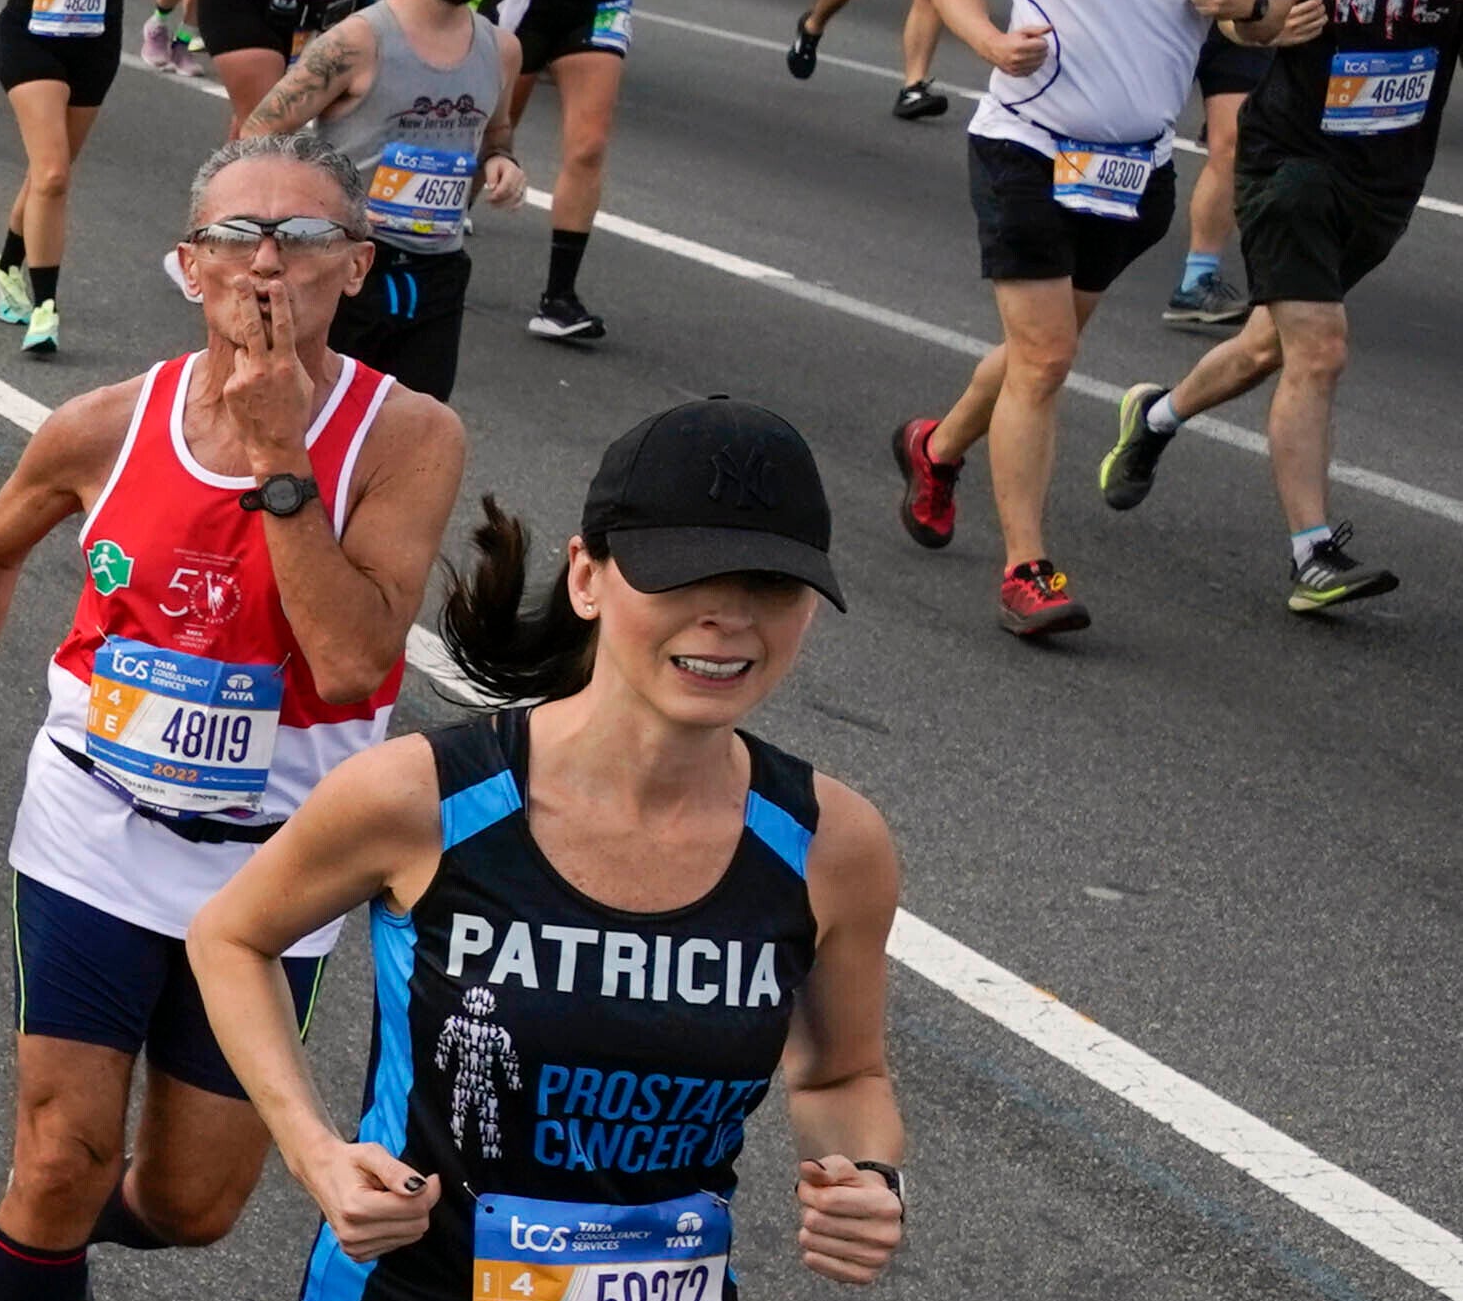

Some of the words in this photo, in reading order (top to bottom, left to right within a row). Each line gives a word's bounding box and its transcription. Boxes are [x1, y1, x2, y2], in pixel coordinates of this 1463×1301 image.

[1371, 74, 1426, 104] 46485
[394, 151, 419, 168] tcs
[1097, 159, 1145, 190] 48300
[414, 179, 466, 206] 46578
[112, 648, 149, 681] tcs
[152, 658, 179, 672] TATA
[150, 676, 188, 693] SERVICES
[151, 666, 210, 689] CONSULTANCY
[106, 687, 122, 705] 4
[221, 689, 255, 702] TATA
[103, 714, 118, 733] E
[161, 707, 253, 764] 48119
[151, 761, 199, 782] 2022
[445, 912, 783, 1009] PATRICIA
[535, 1121, 698, 1174] CANCER
[510, 1216, 570, 1253] tcs
[573, 1230, 652, 1242] CONSULTANCY
[578, 1221, 613, 1233] TATA
[571, 1240, 620, 1253] SERVICES
[665, 1235, 703, 1249] TATA
[509, 1272, 534, 1297] 4
